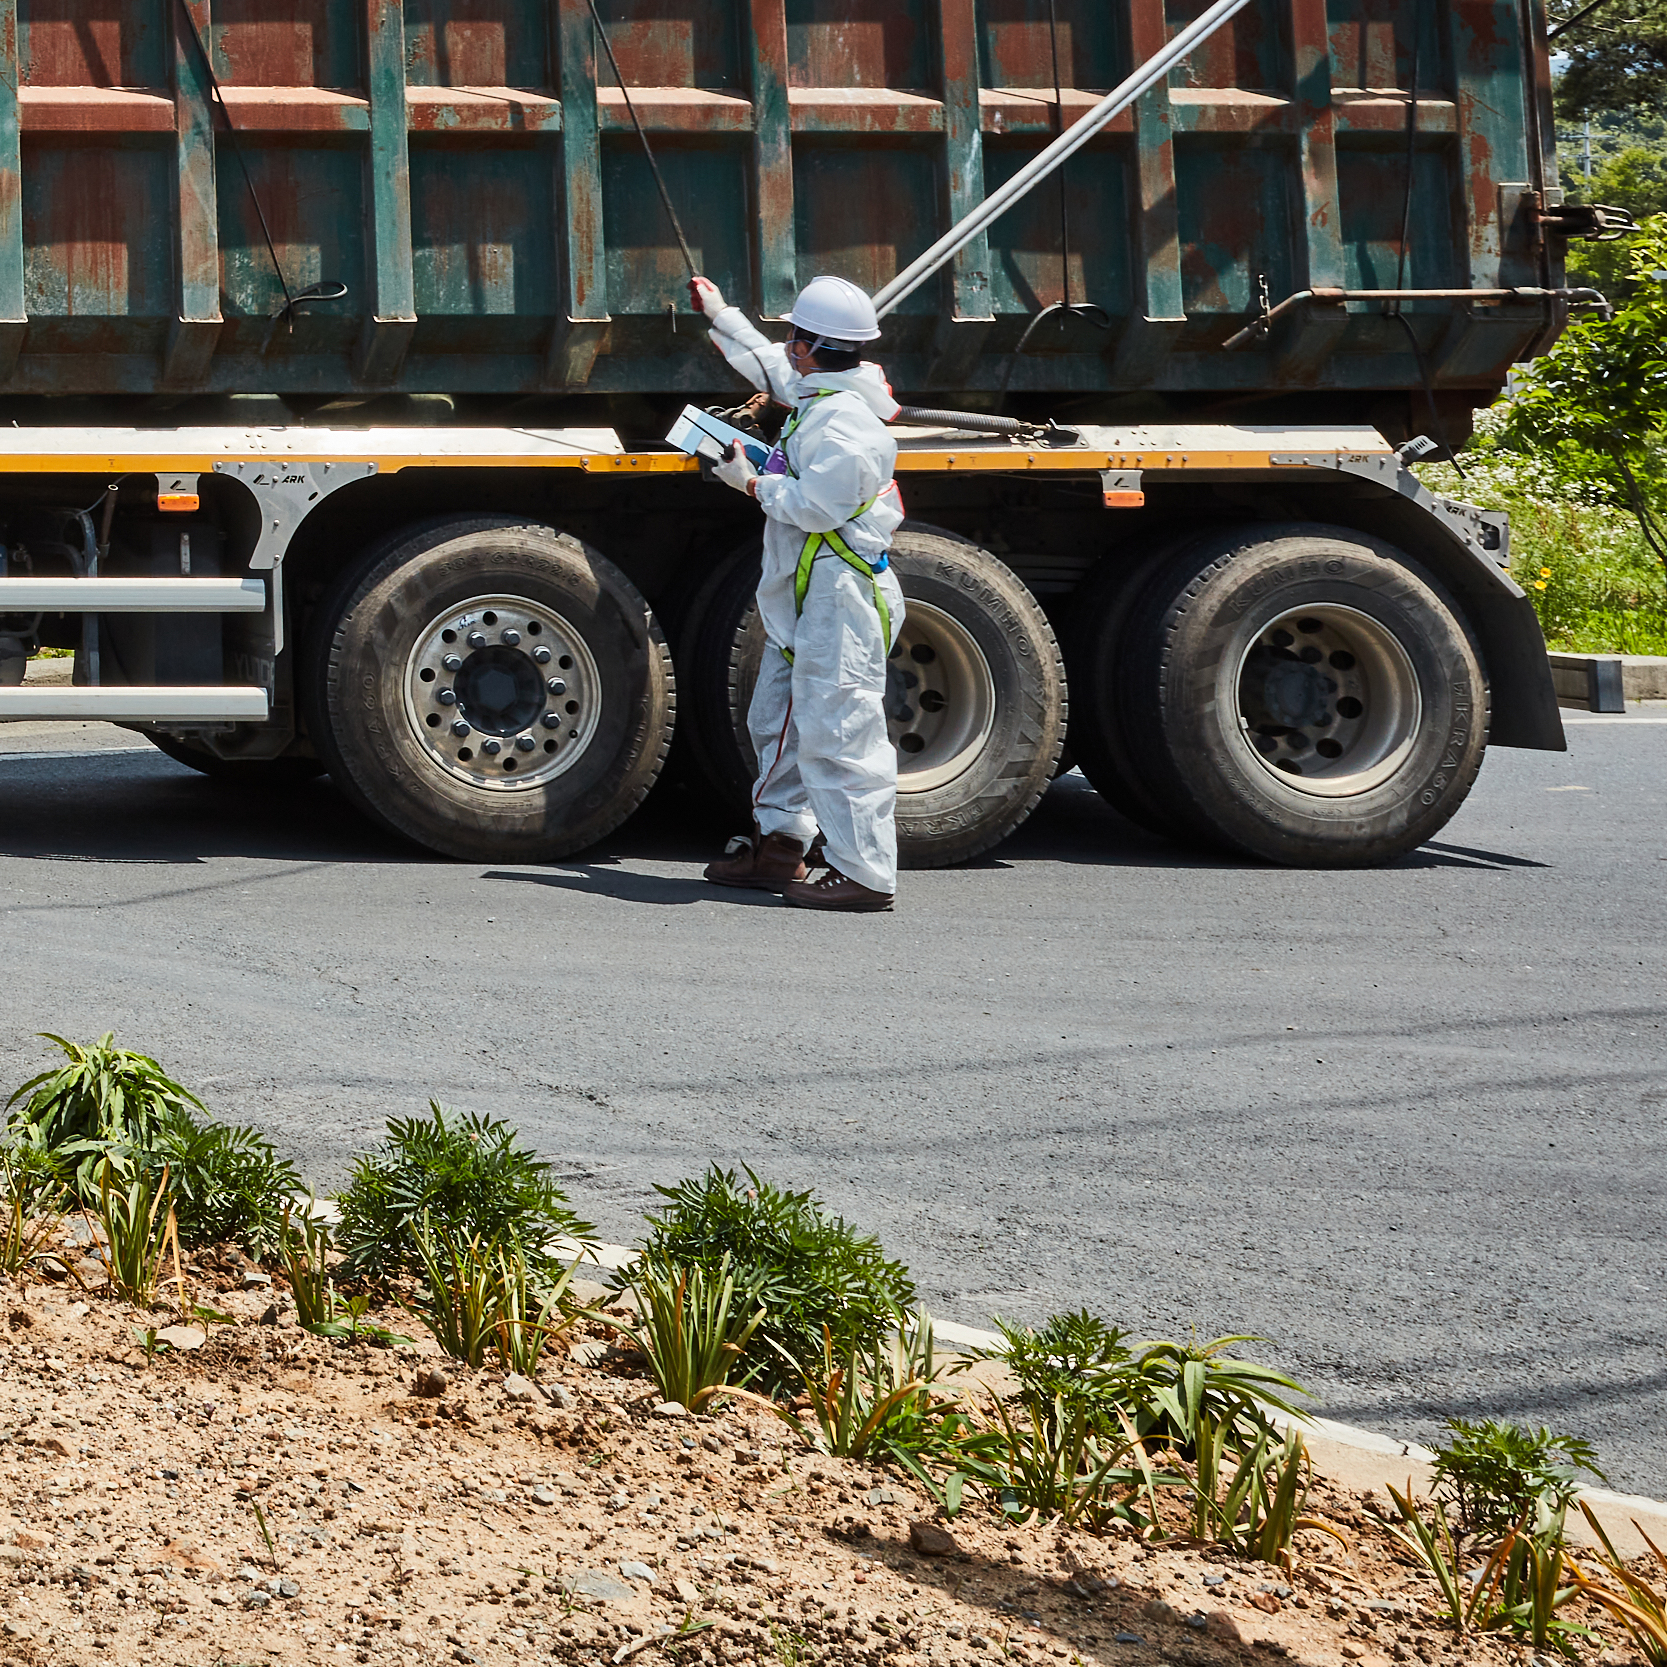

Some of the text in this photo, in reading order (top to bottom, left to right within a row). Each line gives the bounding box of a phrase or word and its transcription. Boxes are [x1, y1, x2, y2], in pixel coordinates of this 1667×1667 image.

[281, 475, 306, 484] ARK
[935, 561, 1031, 657] KUMHO
[1230, 560, 1346, 616] KUMHO
[1420, 700, 1468, 806] KRA60
